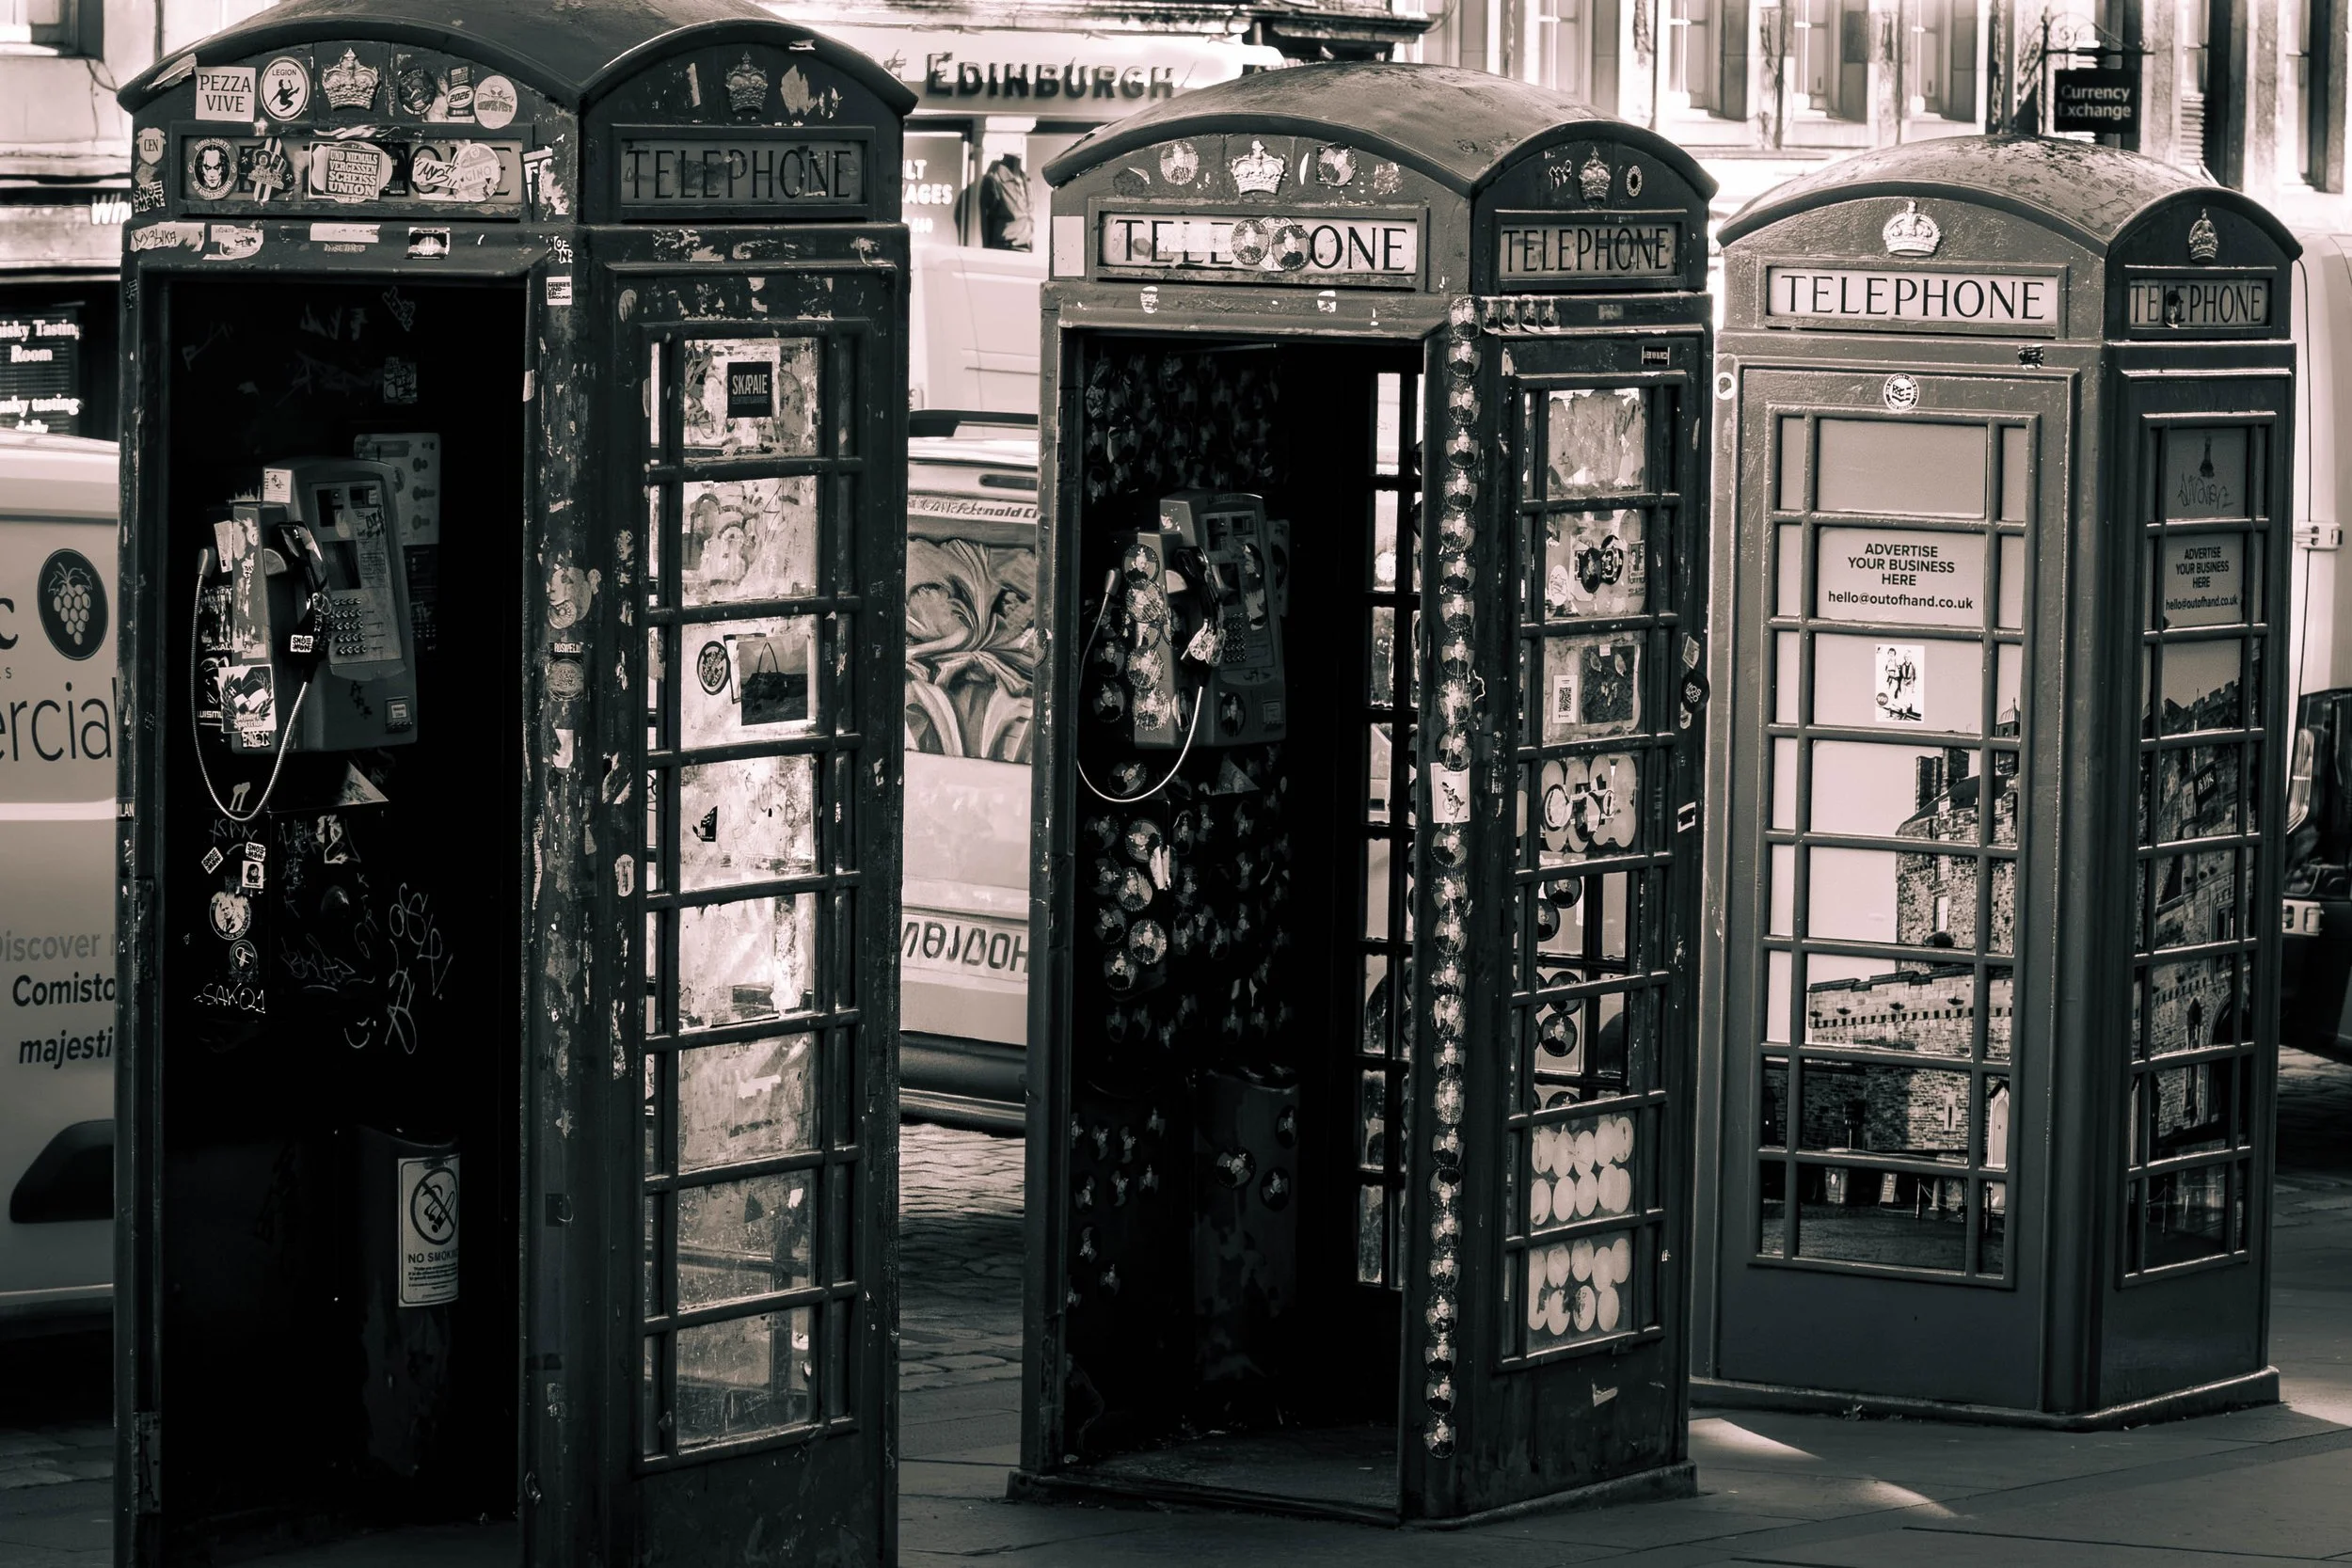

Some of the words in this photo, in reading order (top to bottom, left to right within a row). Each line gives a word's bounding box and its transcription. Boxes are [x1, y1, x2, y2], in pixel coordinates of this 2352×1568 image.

[199, 74, 252, 93] PEZZA
[926, 51, 1175, 99] EDINBURGH
[449, 90, 470, 103] 2026
[2061, 84, 2131, 103] Currency
[205, 94, 245, 113] VIVE
[2058, 102, 2132, 120] Exchange
[330, 150, 345, 162] UND
[345, 150, 378, 166] NIEMALS
[328, 159, 377, 176] VERGESSEN
[625, 148, 852, 200] TELEPHONE
[902, 159, 928, 181] LT
[328, 170, 377, 185] SCHEISS
[327, 181, 376, 198] UNION
[902, 182, 954, 205] AGES
[1502, 228, 1669, 273] TELEPHONE
[1781, 275, 2044, 320] TELEPHONE
[10, 344, 54, 363] Room
[31, 393, 81, 416] tasting
[1865, 543, 1939, 558] ADVERTISE
[2184, 546, 2222, 561] ADVERTISE
[1848, 557, 1885, 570] YOUR
[1888, 560, 1956, 574] BUSINESS
[2175, 562, 2195, 576] YOUR
[2196, 561, 2230, 575] BUSINESS
[1881, 574, 1917, 587] HERE
[2192, 576, 2211, 590] HERE
[1828, 590, 1974, 610] hello@outofhand.co.uk
[2165, 594, 2239, 611] hello@outofhand.co.uk
[235, 712, 261, 723] Berliner
[0, 929, 102, 962] iscover
[12, 971, 115, 1007] Comisto
[19, 1026, 114, 1070] majesti
[407, 1253, 425, 1263] NO
